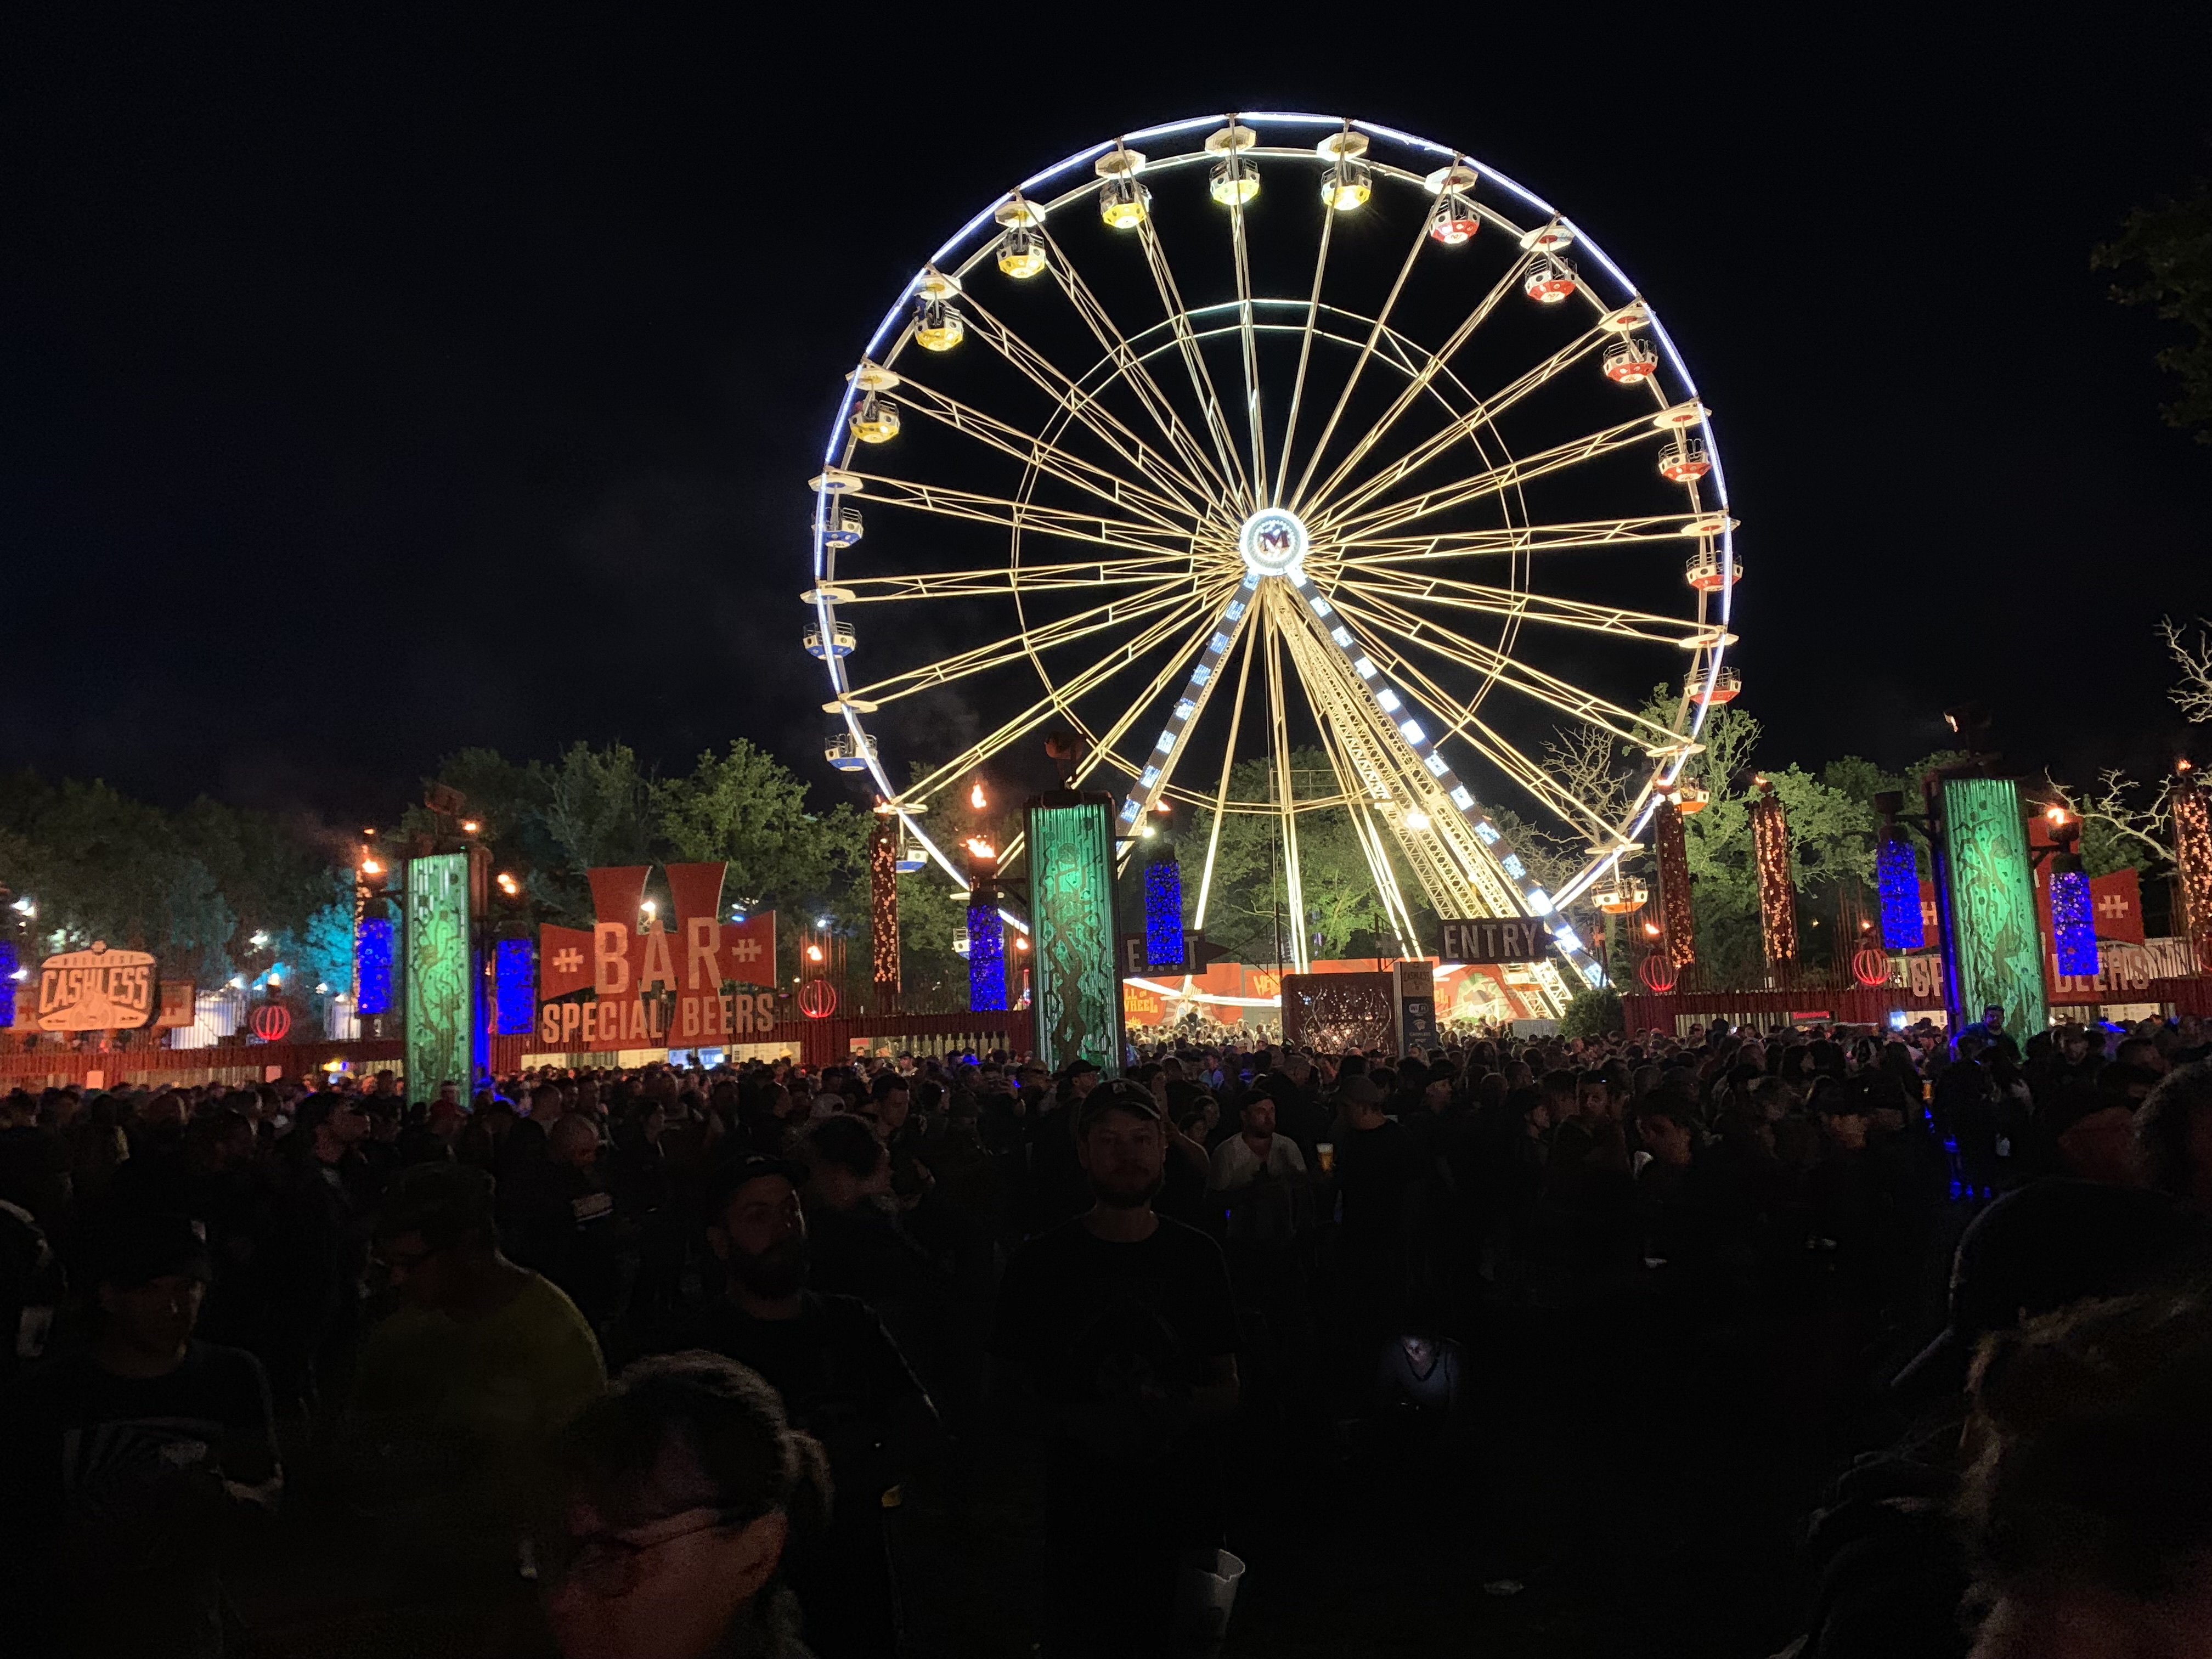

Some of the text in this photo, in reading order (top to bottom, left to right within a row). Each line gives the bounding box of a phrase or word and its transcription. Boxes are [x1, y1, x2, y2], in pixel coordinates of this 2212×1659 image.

[1261, 531, 1290, 552] M
[594, 917, 723, 994] BAR
[1127, 935, 1199, 973] ET
[1444, 923, 1537, 958] ENTRY
[39, 966, 150, 1014] CASHLESS
[541, 993, 774, 1043] SPECIAL BEERS
